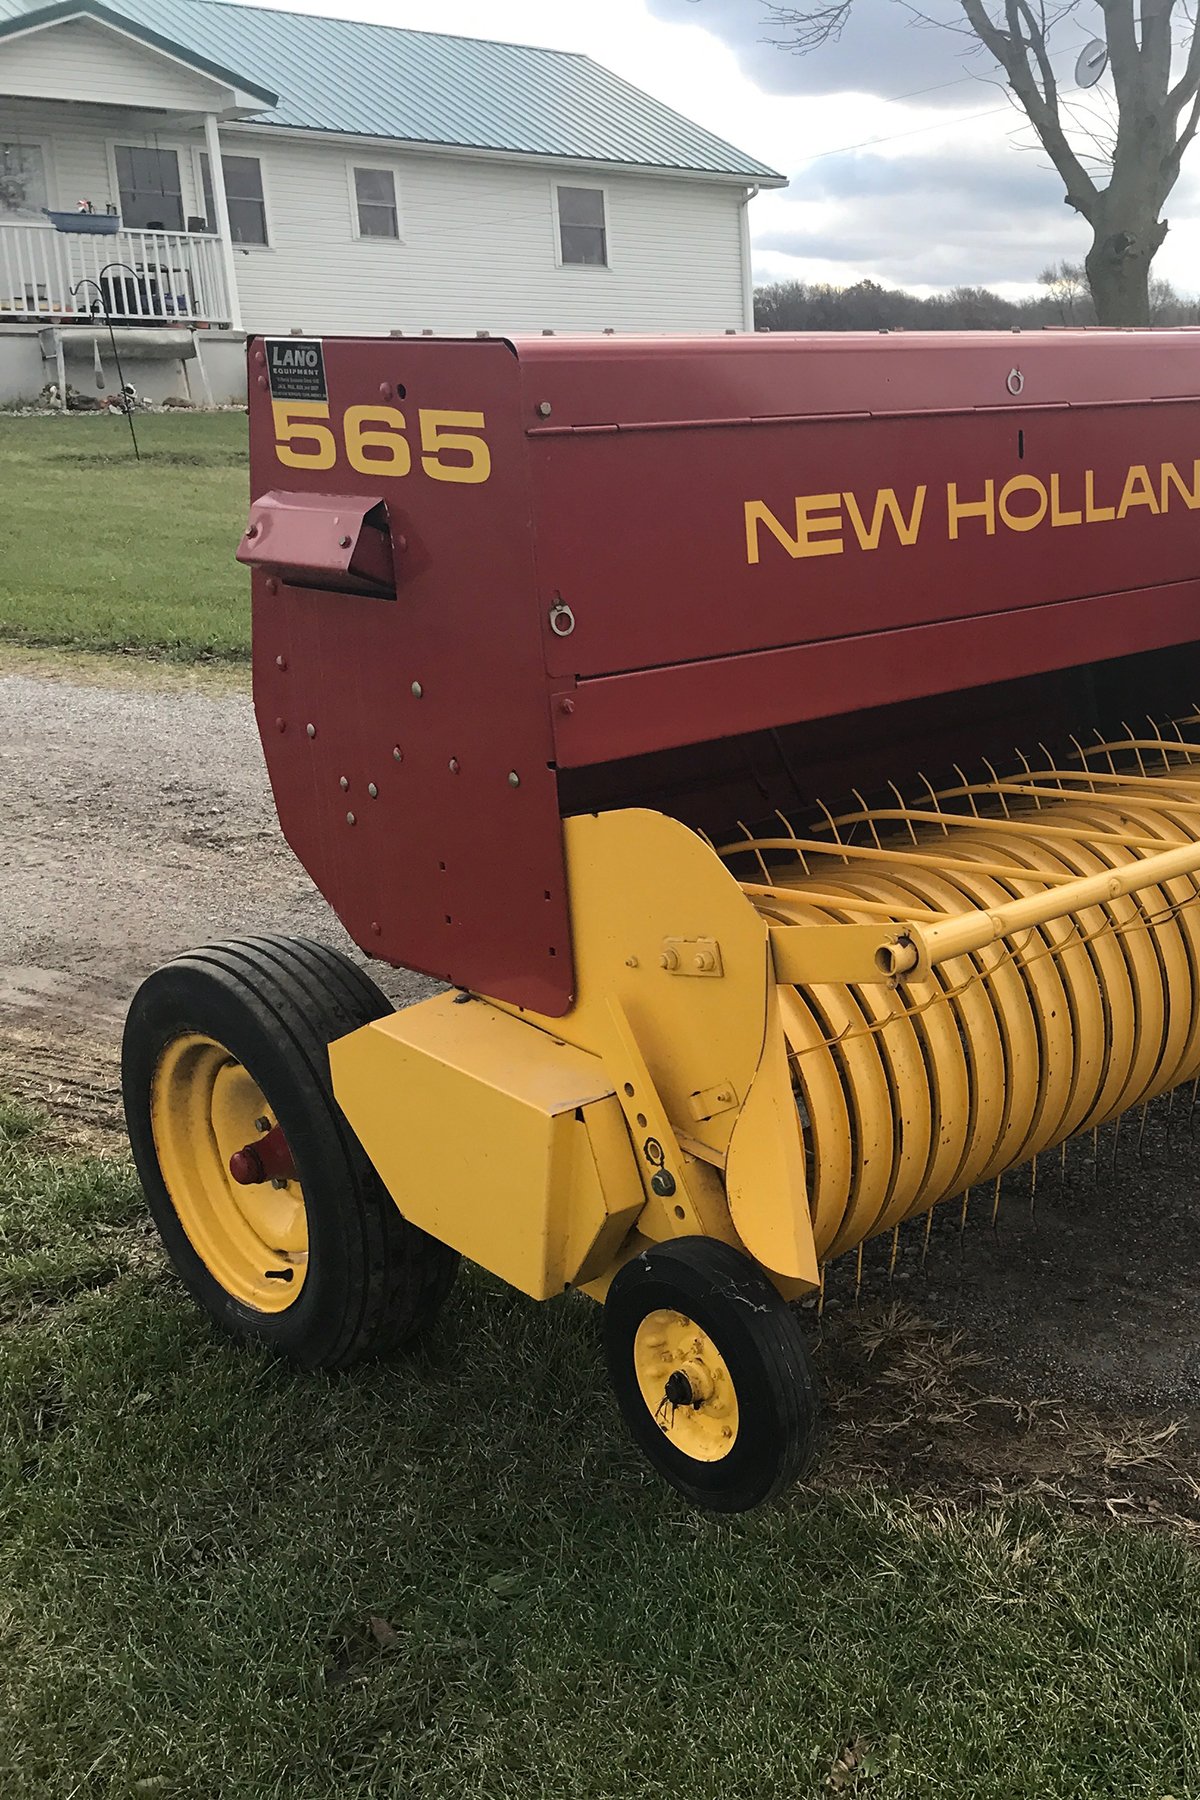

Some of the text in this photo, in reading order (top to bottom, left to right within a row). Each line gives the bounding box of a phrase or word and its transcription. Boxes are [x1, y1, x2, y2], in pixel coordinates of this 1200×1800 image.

[273, 346, 318, 368] LANO
[272, 401, 491, 484] 565
[744, 484, 927, 564] NEW
